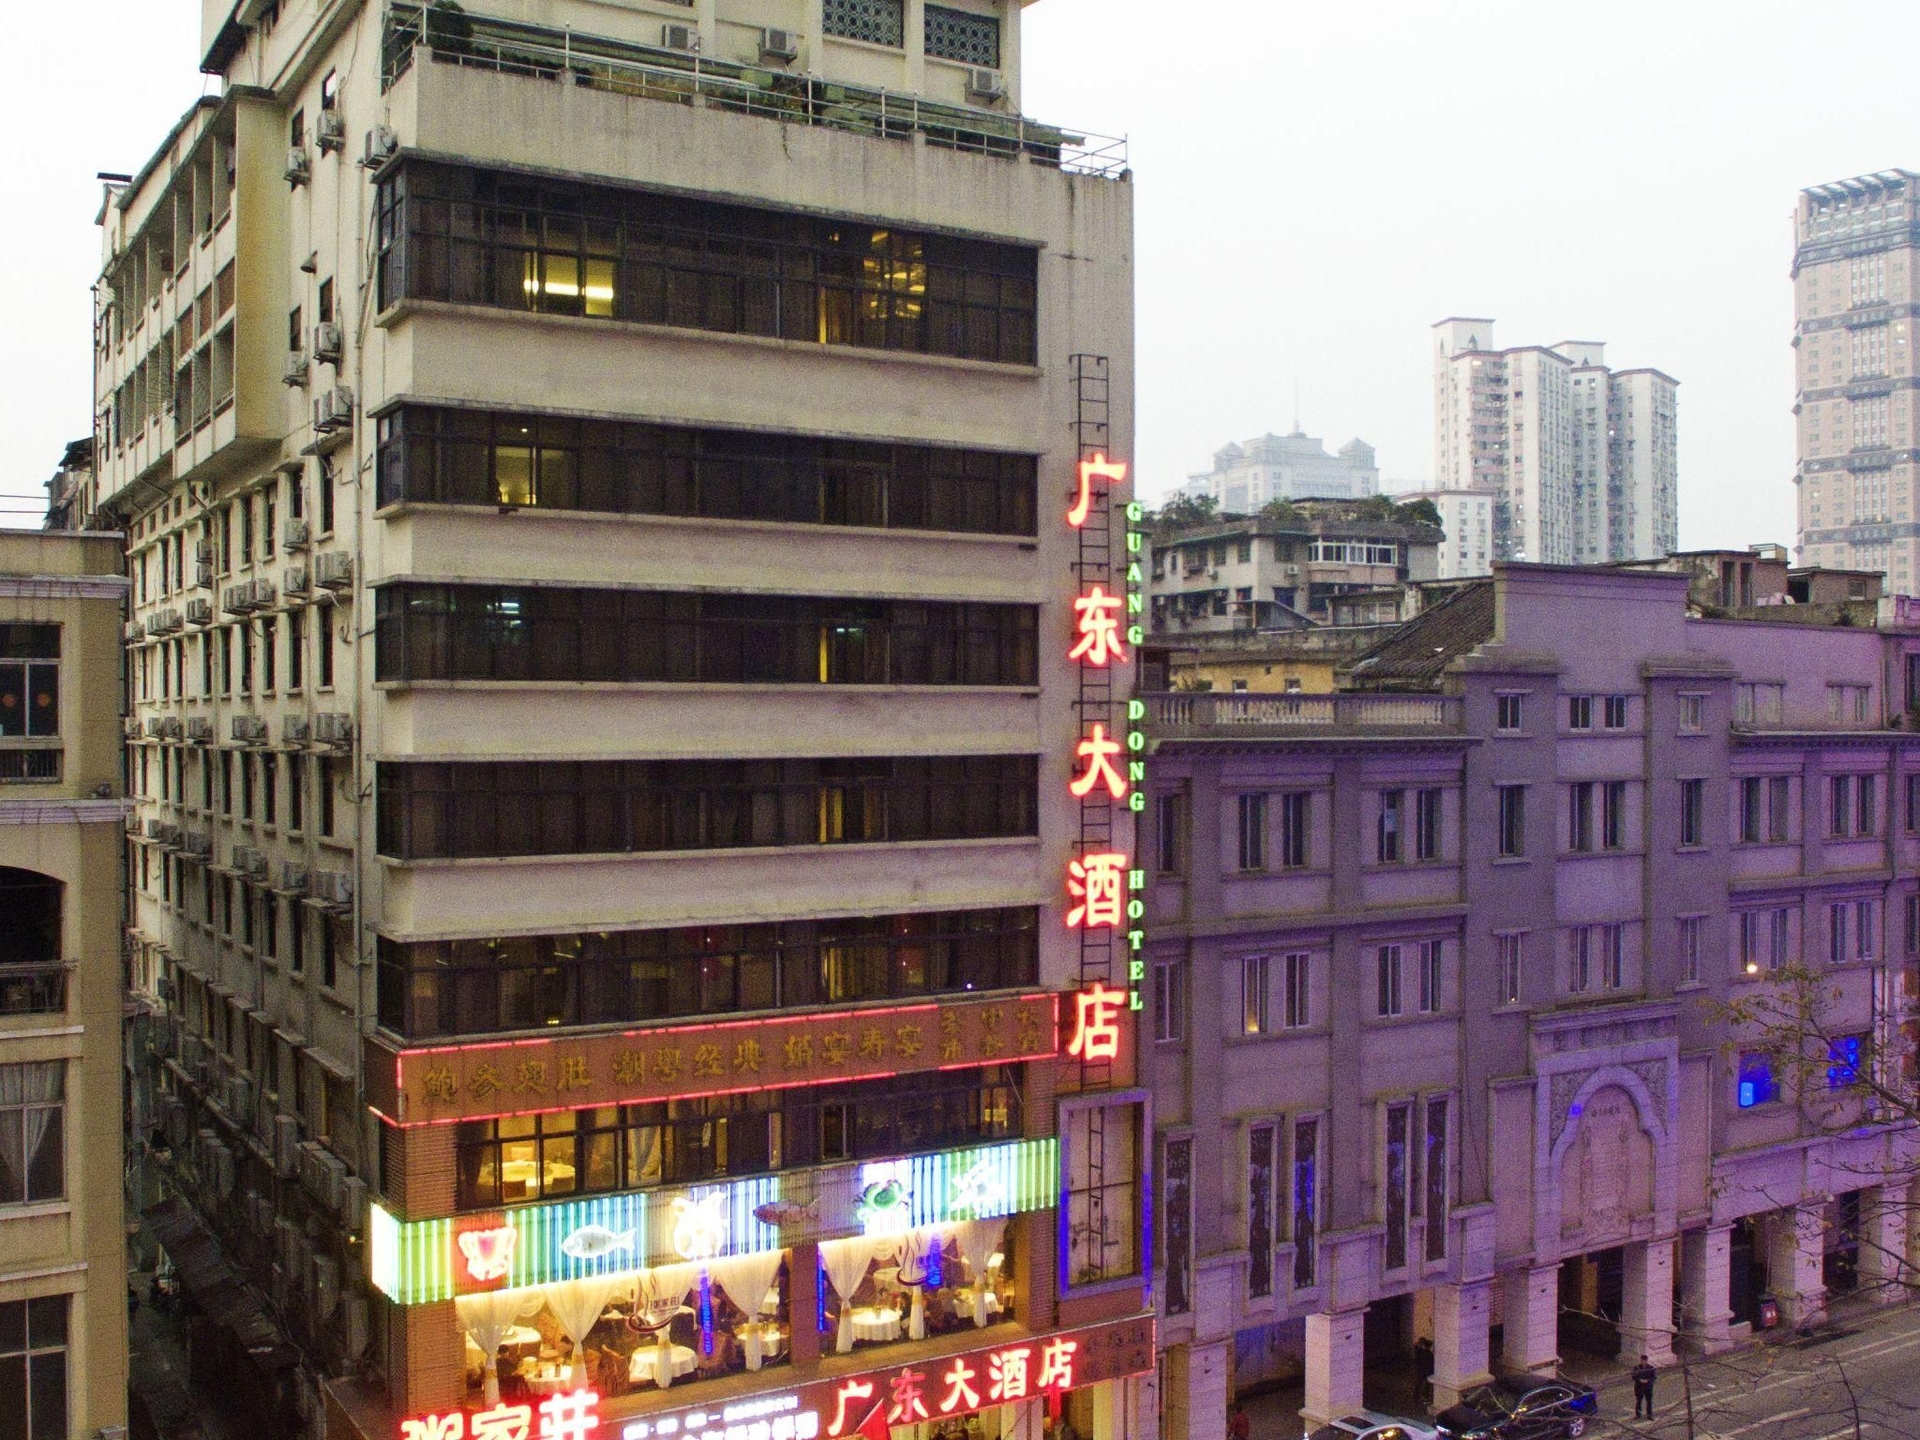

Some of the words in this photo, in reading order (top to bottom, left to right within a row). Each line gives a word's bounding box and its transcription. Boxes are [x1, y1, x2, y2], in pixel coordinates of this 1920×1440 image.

[1126, 502, 1143, 645] GUANG
[1067, 453, 1127, 1060] 广东大酒店
[1128, 699, 1146, 812] DONG
[1128, 870, 1145, 1011] HOTEL
[828, 1338, 1077, 1436] 广东大酒店
